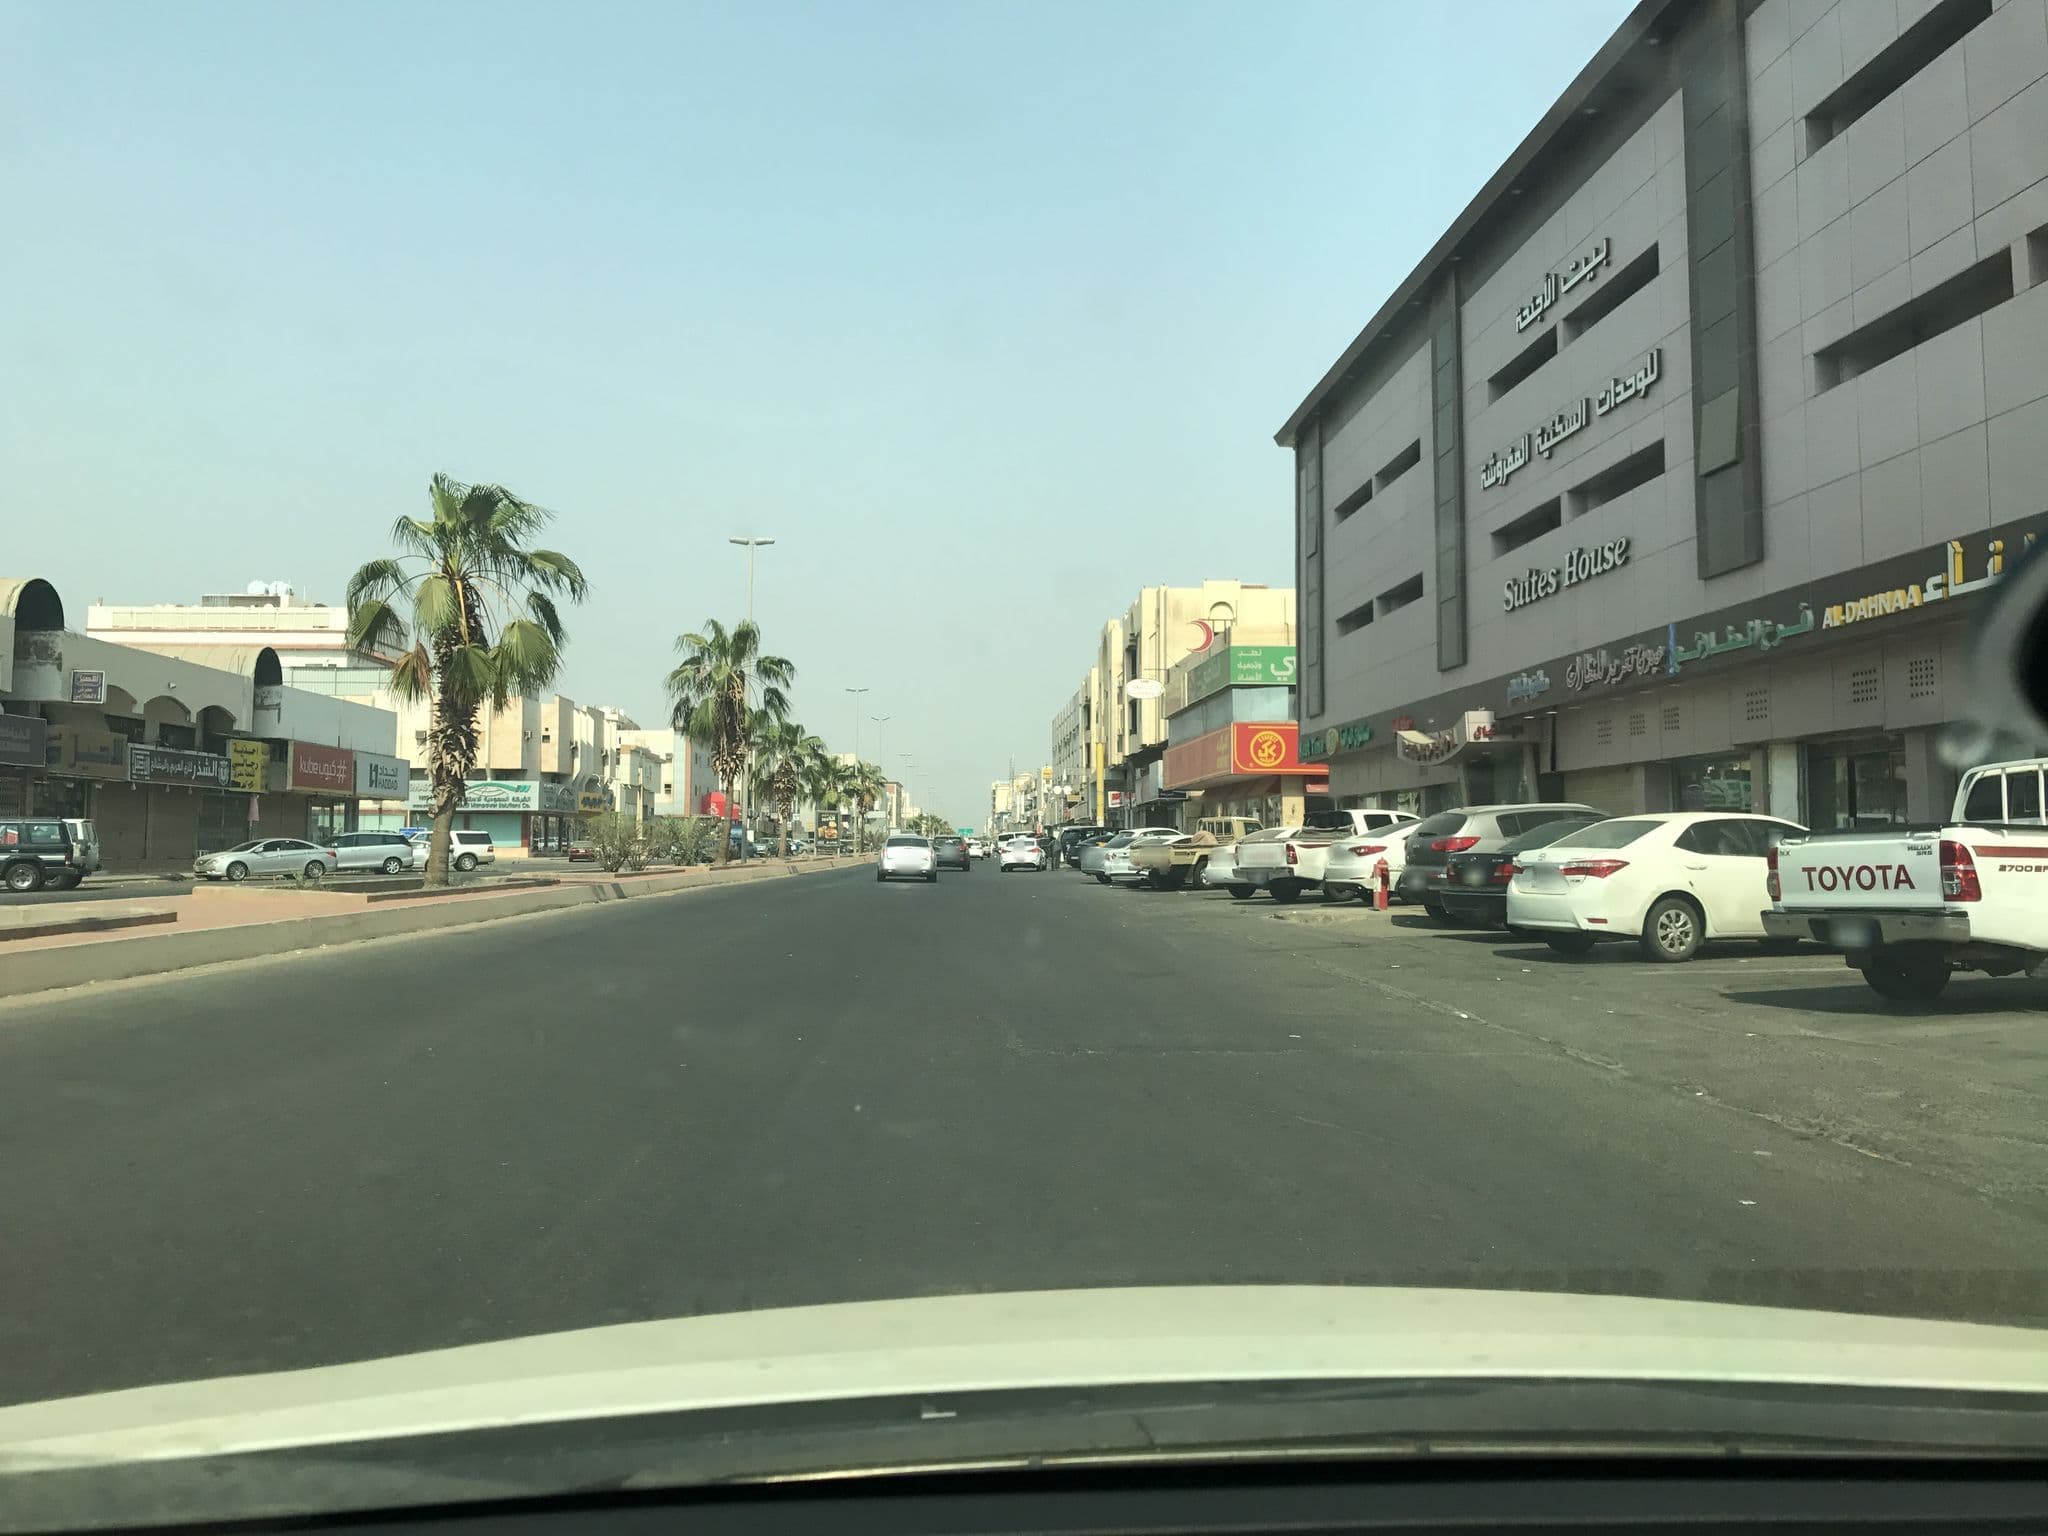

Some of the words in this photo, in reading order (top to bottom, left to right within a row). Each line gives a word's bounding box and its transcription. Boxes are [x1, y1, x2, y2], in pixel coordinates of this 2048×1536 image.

[1560, 237, 1610, 293] بيت
[1515, 272, 1558, 333] الأجنحة
[1596, 348, 1662, 416] للوحدات
[1535, 397, 1590, 459] السكنية
[1480, 433, 1531, 489] المفروشة
[1503, 567, 1558, 611] Suites
[1562, 536, 1628, 587] House
[1822, 584, 1924, 629] AL-DAHNAA
[300, 753, 319, 776] kube
[1801, 864, 1916, 892] TOYOTA
[1998, 864, 2033, 872] 2700
